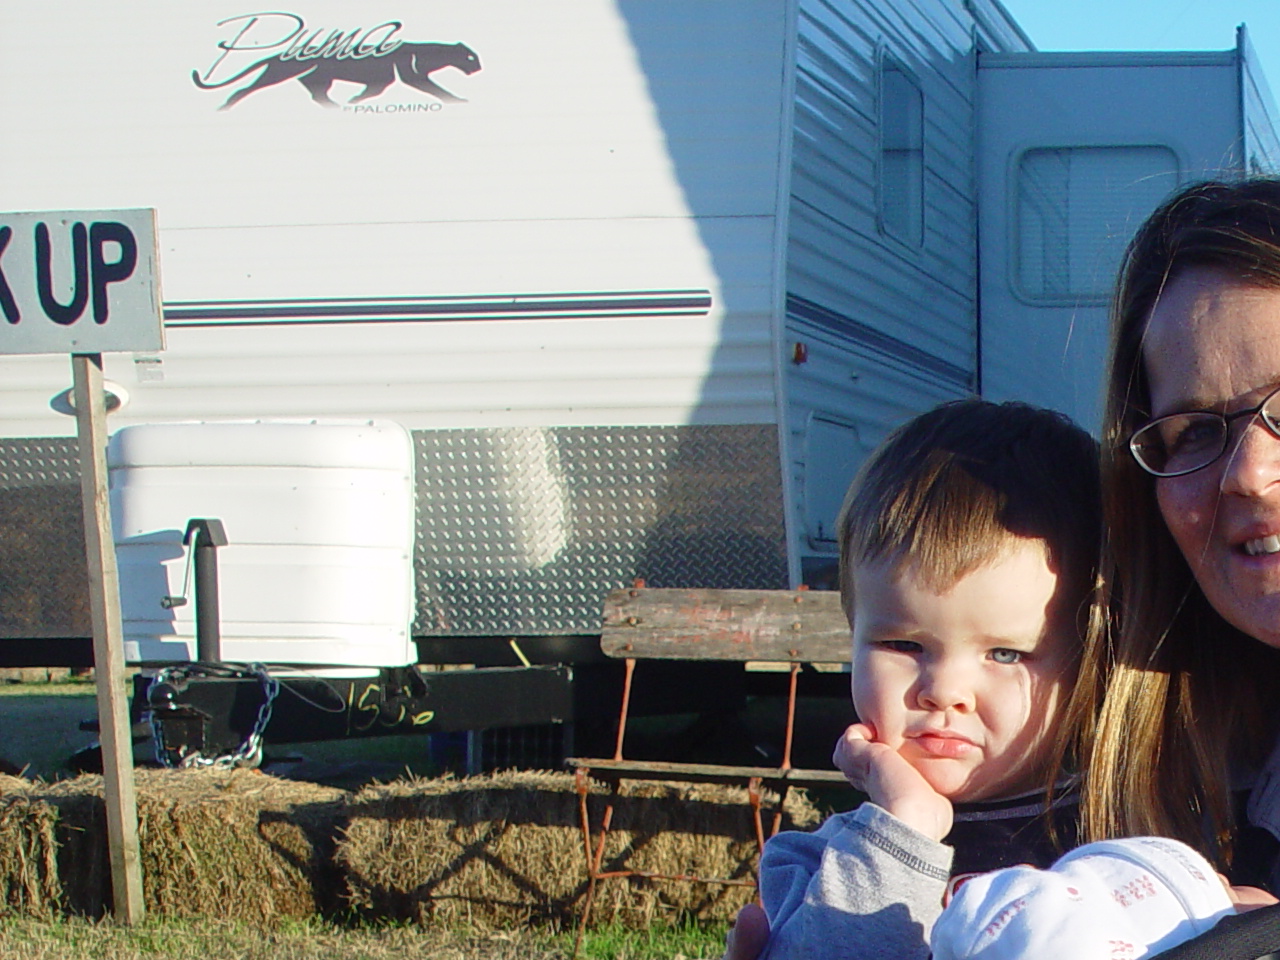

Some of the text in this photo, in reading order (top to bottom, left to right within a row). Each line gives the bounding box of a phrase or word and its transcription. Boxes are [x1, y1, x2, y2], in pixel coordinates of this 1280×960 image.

[203, 11, 403, 82] Puma
[354, 103, 443, 114] PALOMINO
[34, 221, 138, 326] UP
